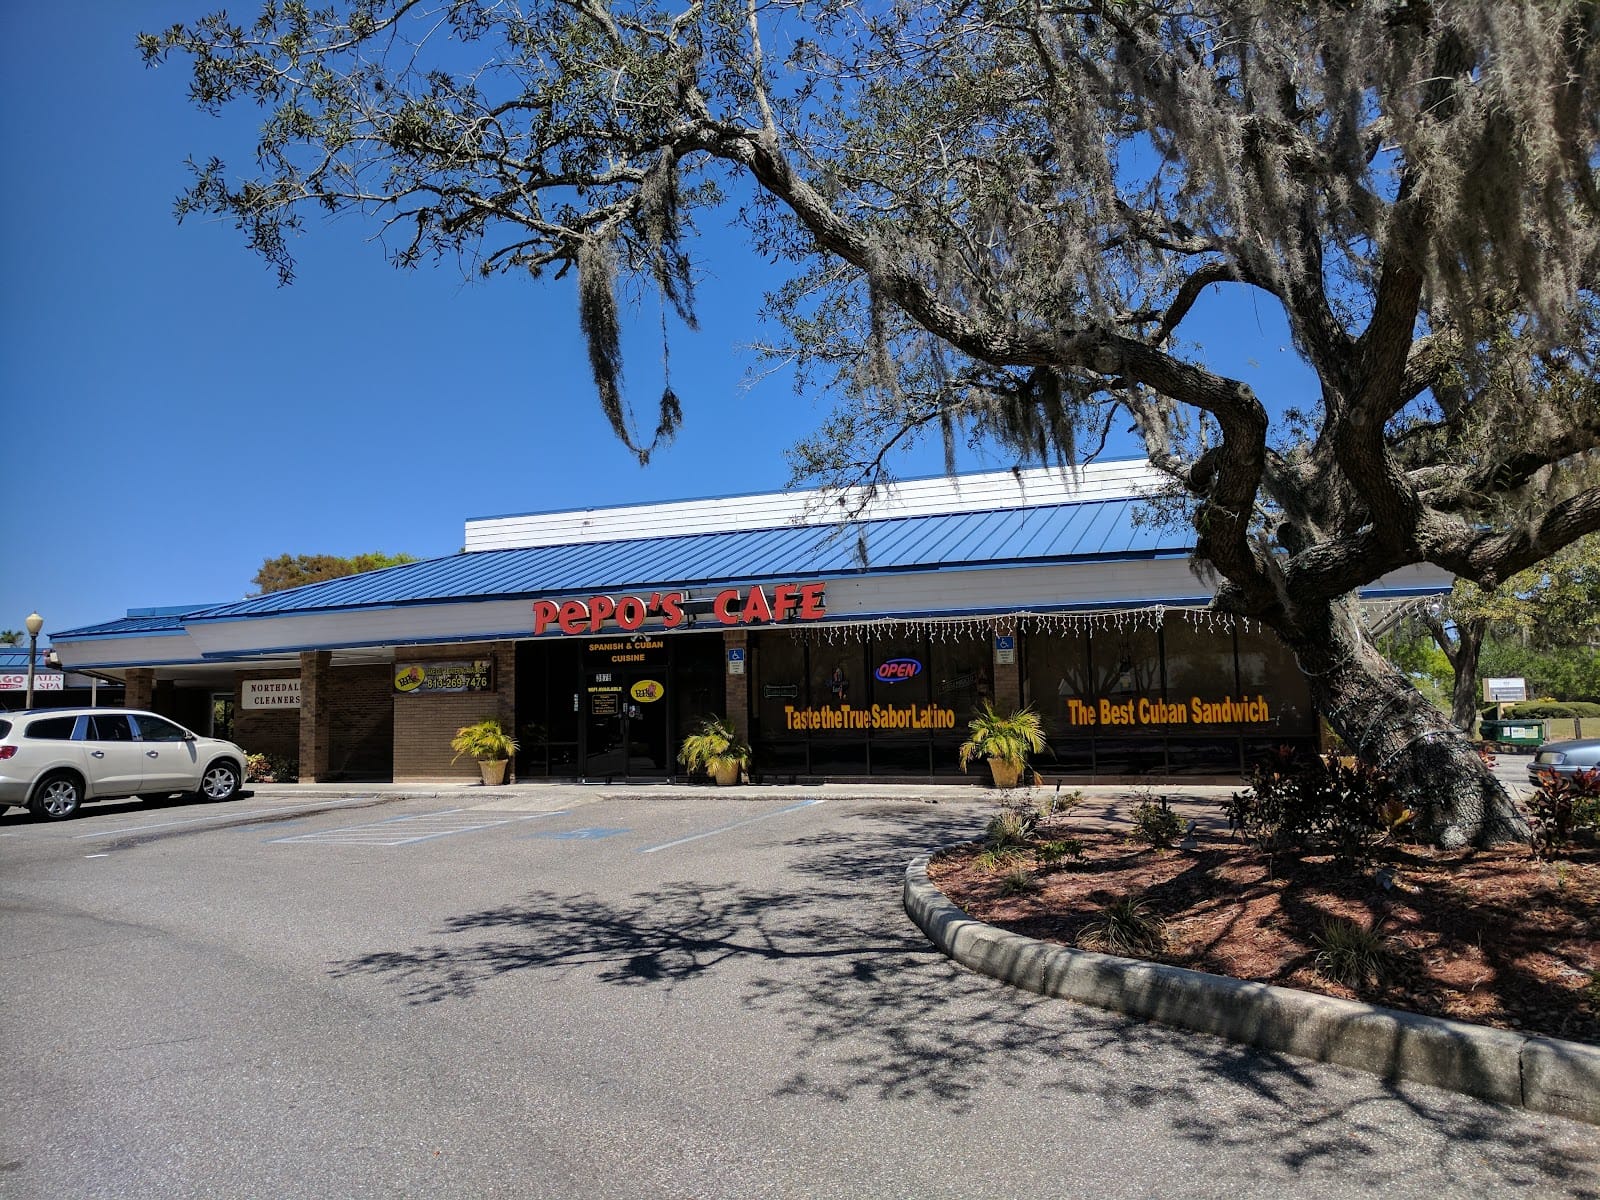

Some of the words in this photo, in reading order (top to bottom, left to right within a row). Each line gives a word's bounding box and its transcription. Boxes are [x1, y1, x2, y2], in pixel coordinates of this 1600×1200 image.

[713, 582, 827, 625] CAFE
[589, 643, 624, 651] SPANISH
[634, 641, 664, 649] CUBAN
[611, 654, 646, 662] CUISINE
[879, 663, 916, 677] OPEN
[251, 683, 301, 692] NORTHDAL
[254, 695, 300, 704] CLEANERS
[1067, 700, 1096, 725] The
[1100, 699, 1135, 725] Best
[1138, 697, 1187, 724] Cuban
[1191, 695, 1269, 724] Sandwich
